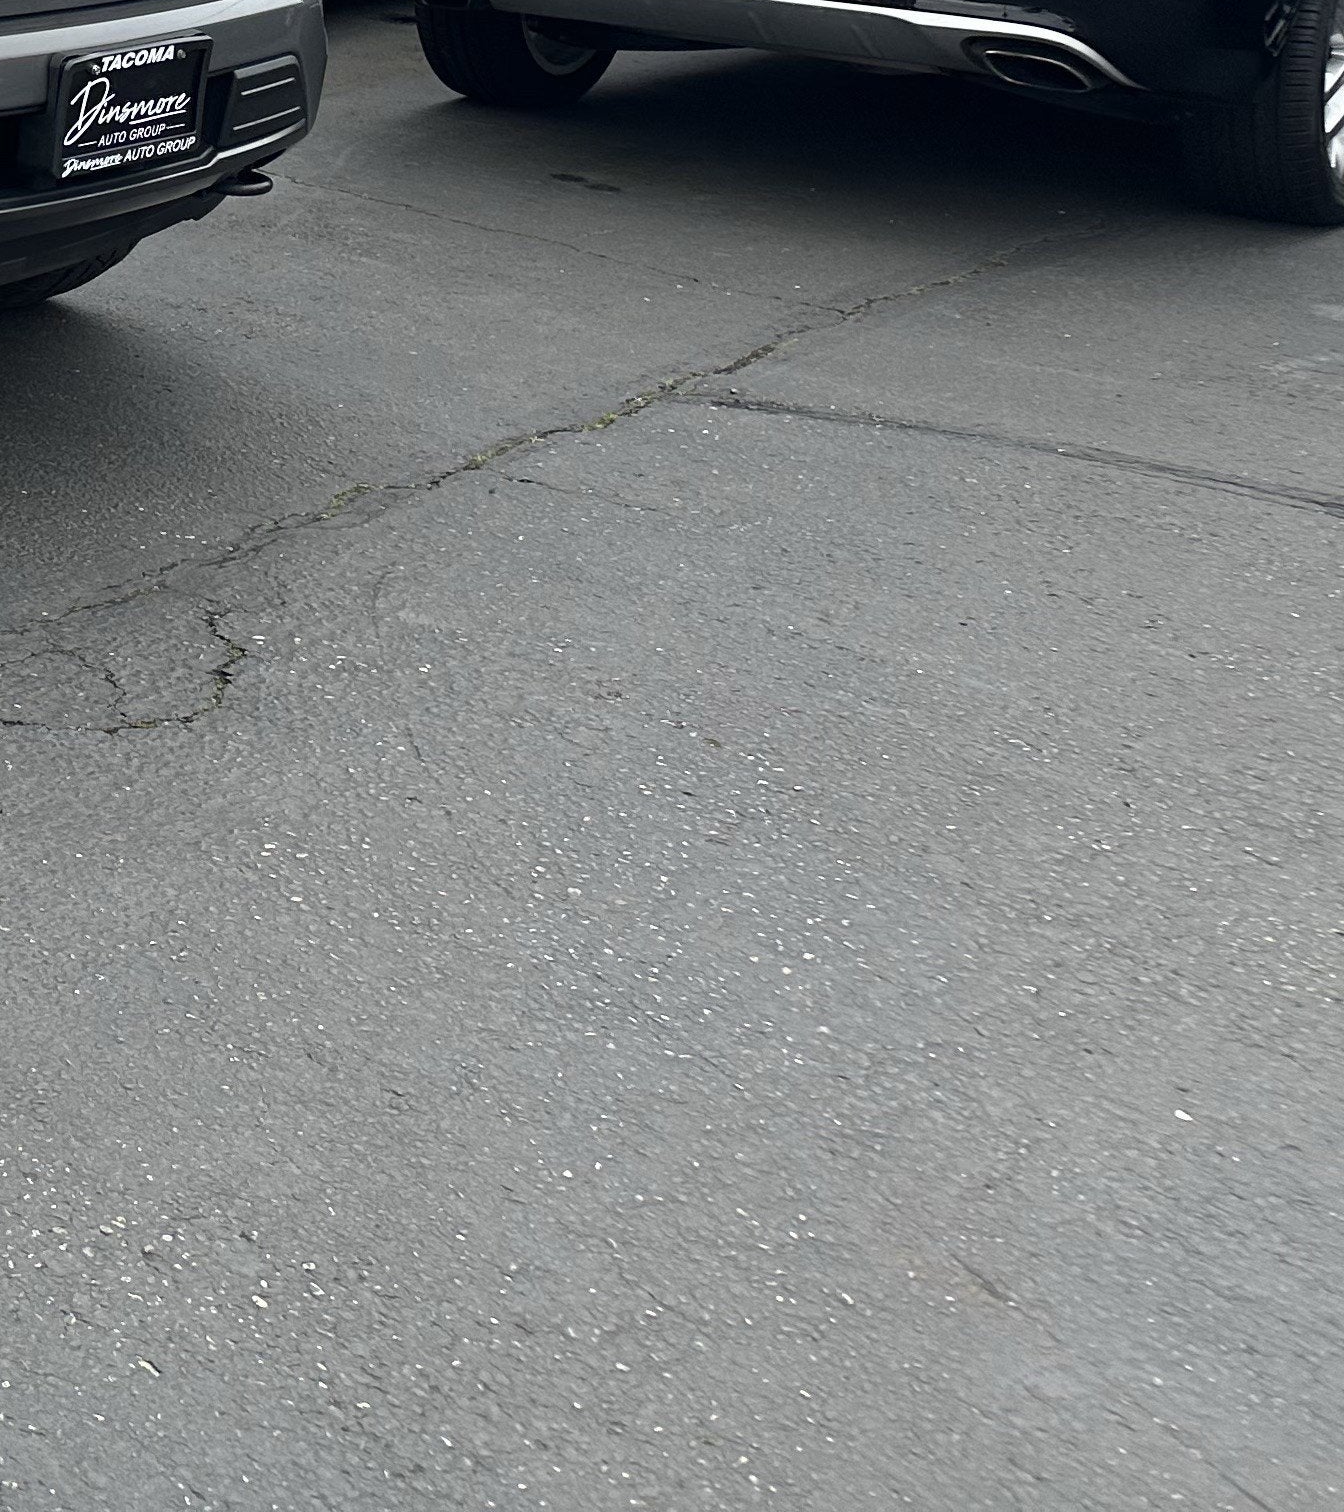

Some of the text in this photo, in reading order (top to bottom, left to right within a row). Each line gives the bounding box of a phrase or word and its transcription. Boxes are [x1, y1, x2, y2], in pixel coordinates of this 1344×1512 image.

[100, 44, 175, 73] TACOMA
[63, 76, 191, 146] Dinsmore
[97, 123, 167, 147] AUTO GROUP
[61, 135, 197, 179] Dinsmore AUTO GROUP
